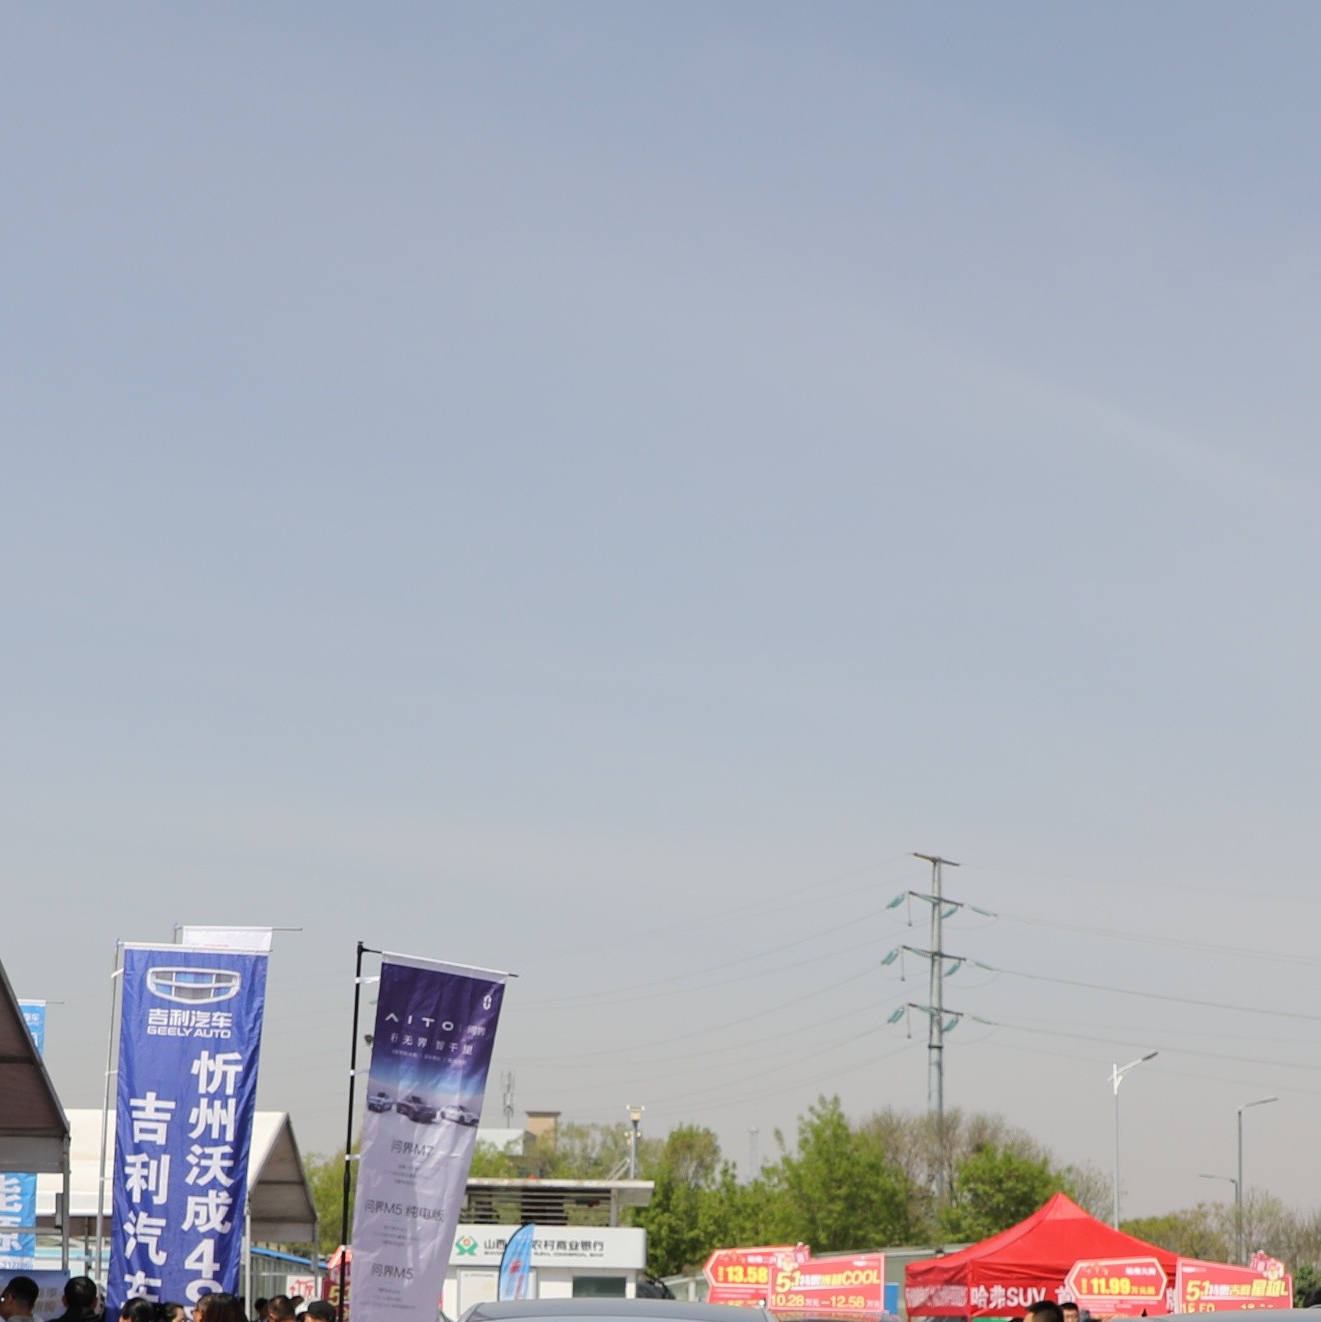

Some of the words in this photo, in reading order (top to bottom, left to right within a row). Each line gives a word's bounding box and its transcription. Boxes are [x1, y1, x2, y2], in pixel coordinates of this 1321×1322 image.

[148, 1008, 232, 1028] 吉利汽车
[147, 1026, 192, 1038] GEELY
[193, 1027, 232, 1039] AUTO
[372, 1263, 414, 1280] 问界M5
[726, 1265, 768, 1284] 13.58
